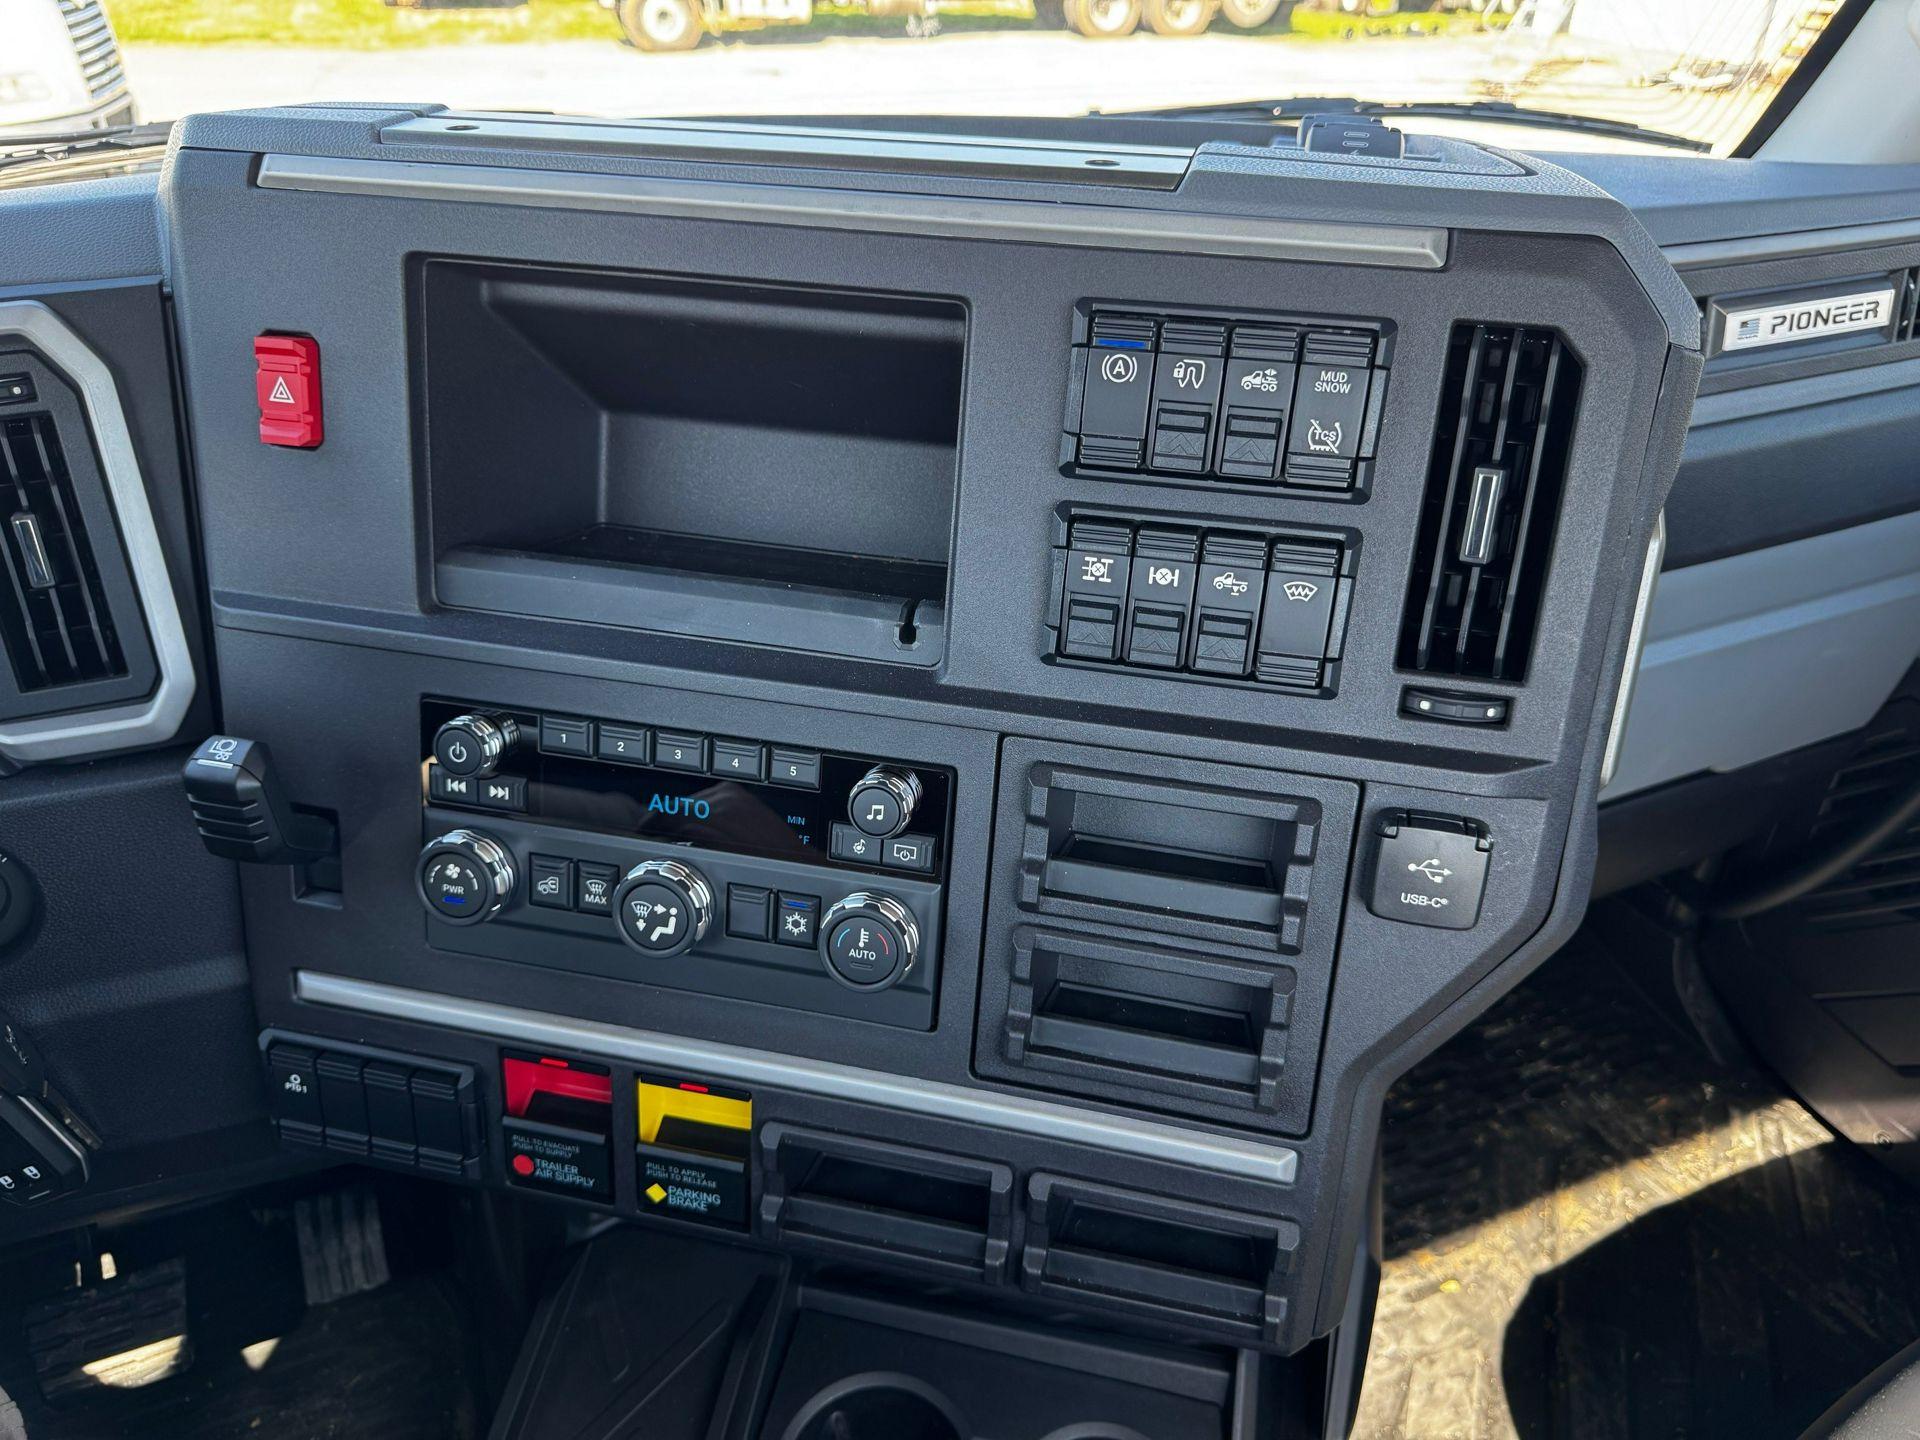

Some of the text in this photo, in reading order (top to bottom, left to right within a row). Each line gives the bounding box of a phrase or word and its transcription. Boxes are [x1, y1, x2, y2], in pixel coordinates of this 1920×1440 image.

[1771, 300, 1880, 334] PIONEER
[1320, 370, 1348, 383] MUD
[1314, 381, 1352, 394] SNOW
[560, 733, 567, 743] 1
[617, 741, 625, 752] 2
[674, 749, 682, 760] 3
[732, 757, 740, 768] 4
[789, 766, 797, 776] 5
[648, 793, 710, 819] AUTO
[787, 815, 806, 825] MIN
[442, 884, 464, 895] PWR
[584, 894, 607, 905] MAX
[849, 948, 876, 961] AUTO
[512, 1134, 530, 1143] PULL
[512, 1141, 533, 1150] PUSH
[535, 1144, 545, 1152] TO
[534, 1158, 579, 1174] TRAILER
[646, 1161, 666, 1171] PULL
[681, 1169, 706, 1178] APPLY
[534, 1167, 596, 1187] AIR SUPPLY
[646, 1168, 669, 1178] PUSH
[670, 1173, 682, 1181] TO
[668, 1185, 721, 1205] PARKING
[668, 1194, 708, 1212] BRAKE
